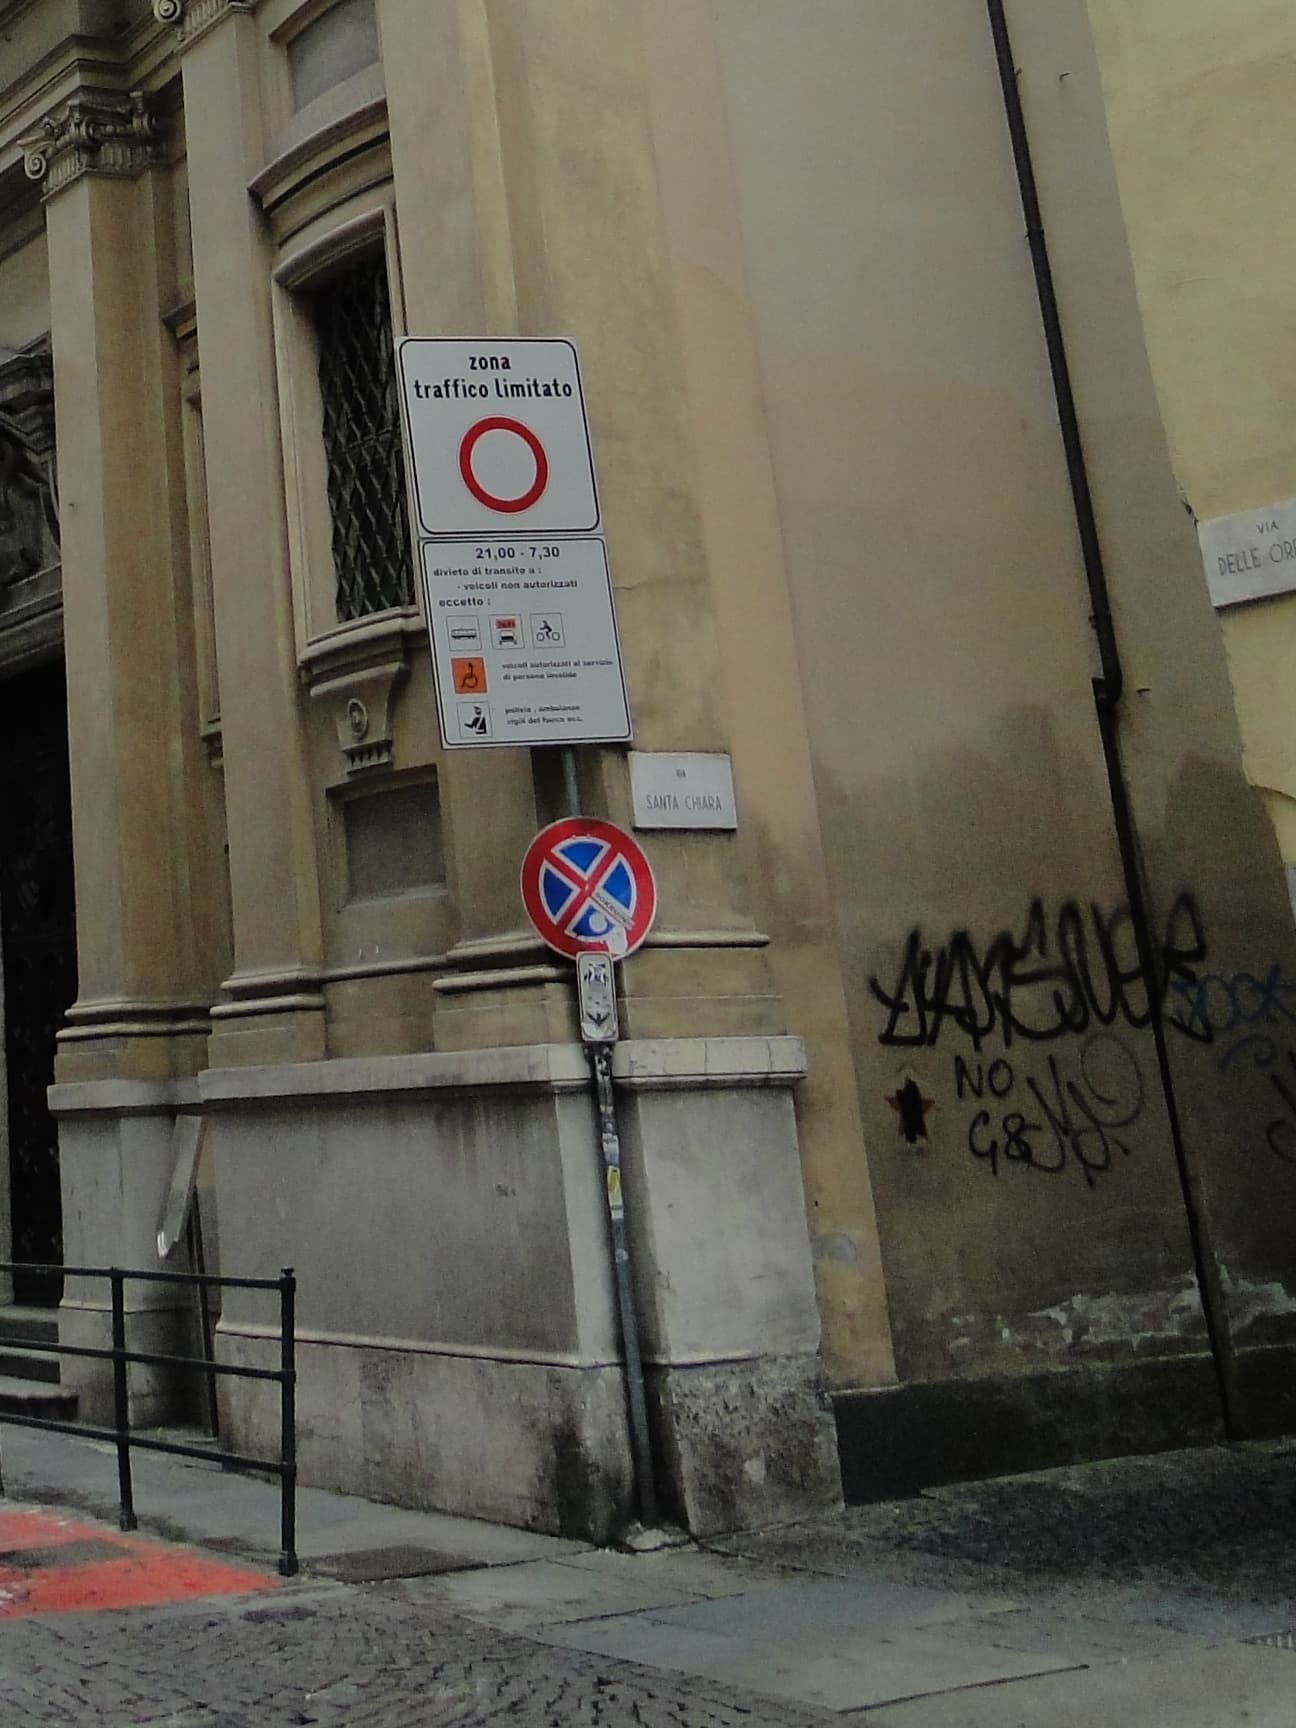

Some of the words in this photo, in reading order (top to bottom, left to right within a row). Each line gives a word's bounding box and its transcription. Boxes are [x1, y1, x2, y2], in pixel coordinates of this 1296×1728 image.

[469, 355, 511, 371] zona
[414, 378, 489, 399] traffico
[494, 377, 572, 398] limitato
[1256, 519, 1280, 535] VIA
[475, 546, 516, 560] 21,00
[529, 546, 560, 560] 7,30
[1217, 547, 1261, 576] DELLE
[433, 567, 469, 577] divieto
[472, 567, 482, 576] di
[485, 566, 526, 576] transito
[464, 581, 498, 590] veicoli
[501, 582, 520, 590] non
[523, 580, 577, 589] autorizzati
[439, 597, 484, 607] eccetto
[646, 794, 679, 810] SANTA
[684, 794, 722, 811] CHIARA
[954, 1054, 1014, 1100] NO
